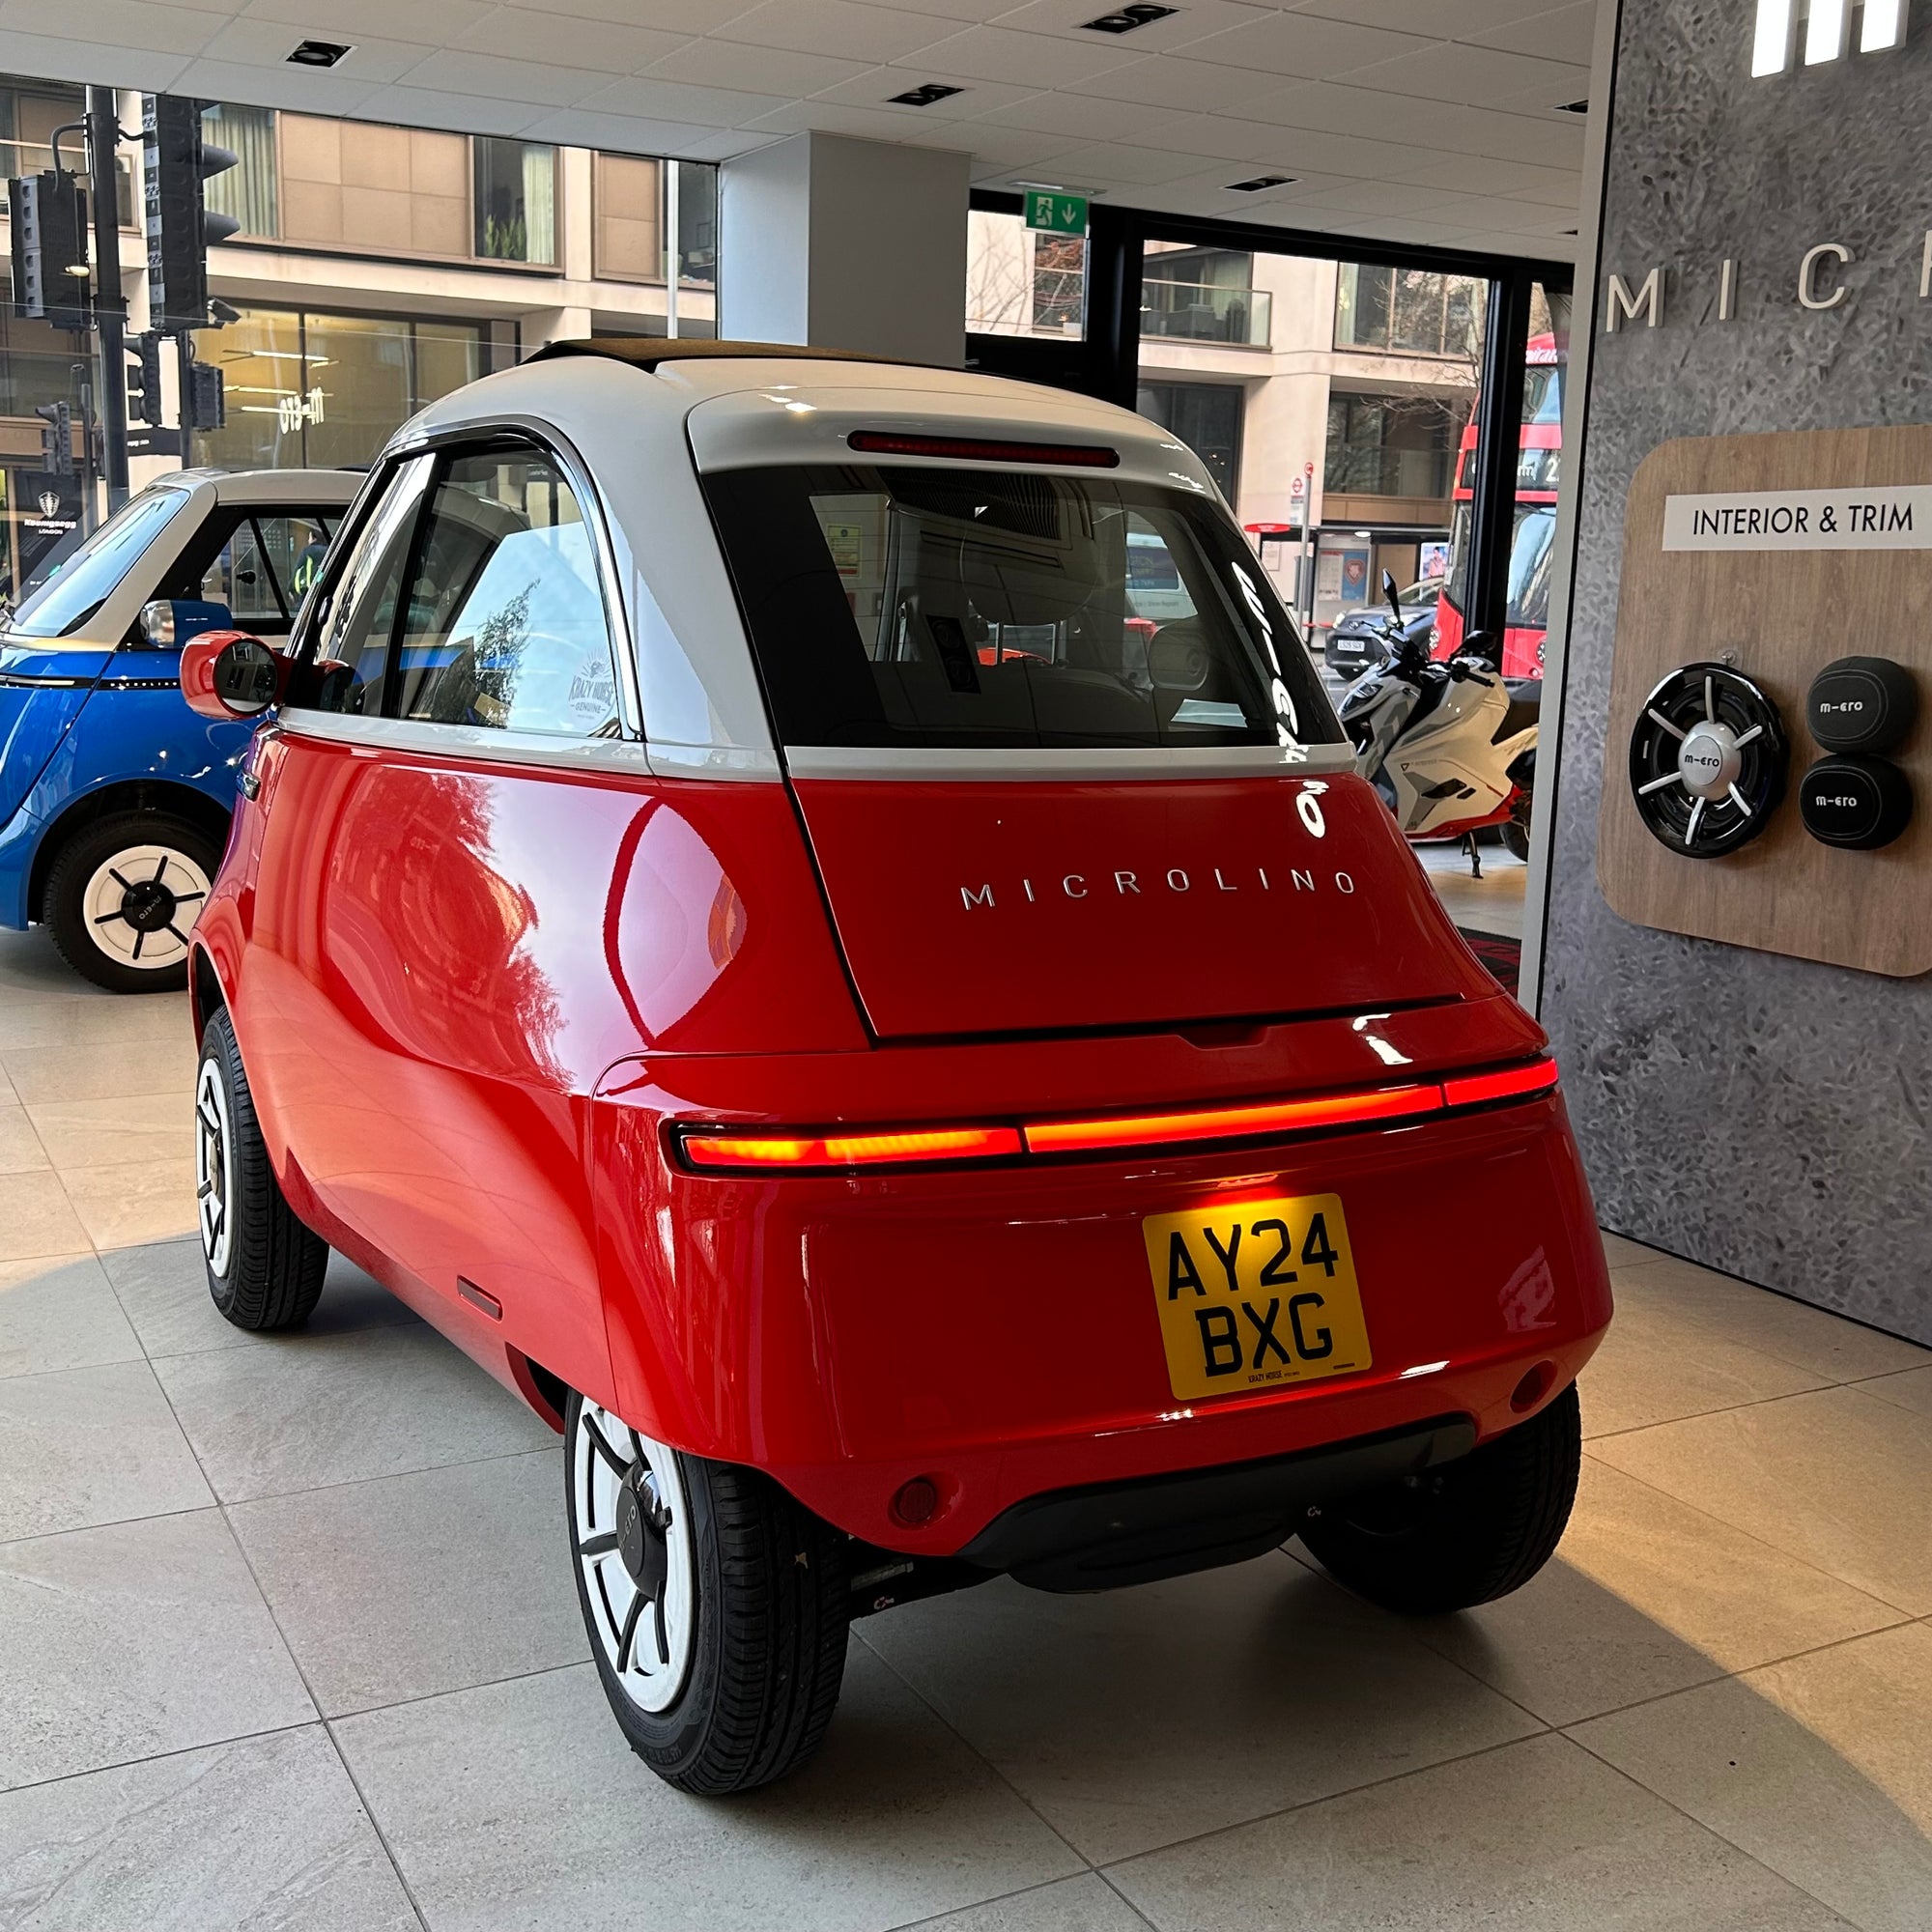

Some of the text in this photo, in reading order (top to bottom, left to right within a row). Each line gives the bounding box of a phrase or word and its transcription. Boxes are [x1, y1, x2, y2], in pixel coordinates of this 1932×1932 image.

[1605, 230, 1932, 333] MIC
[1692, 502, 1913, 535] INTERIOR & TRIM
[575, 701, 602, 714] GENUINE
[960, 867, 1354, 911] MICROLINO
[1167, 1212, 1340, 1301] AY24
[1194, 1292, 1334, 1378] BXG
